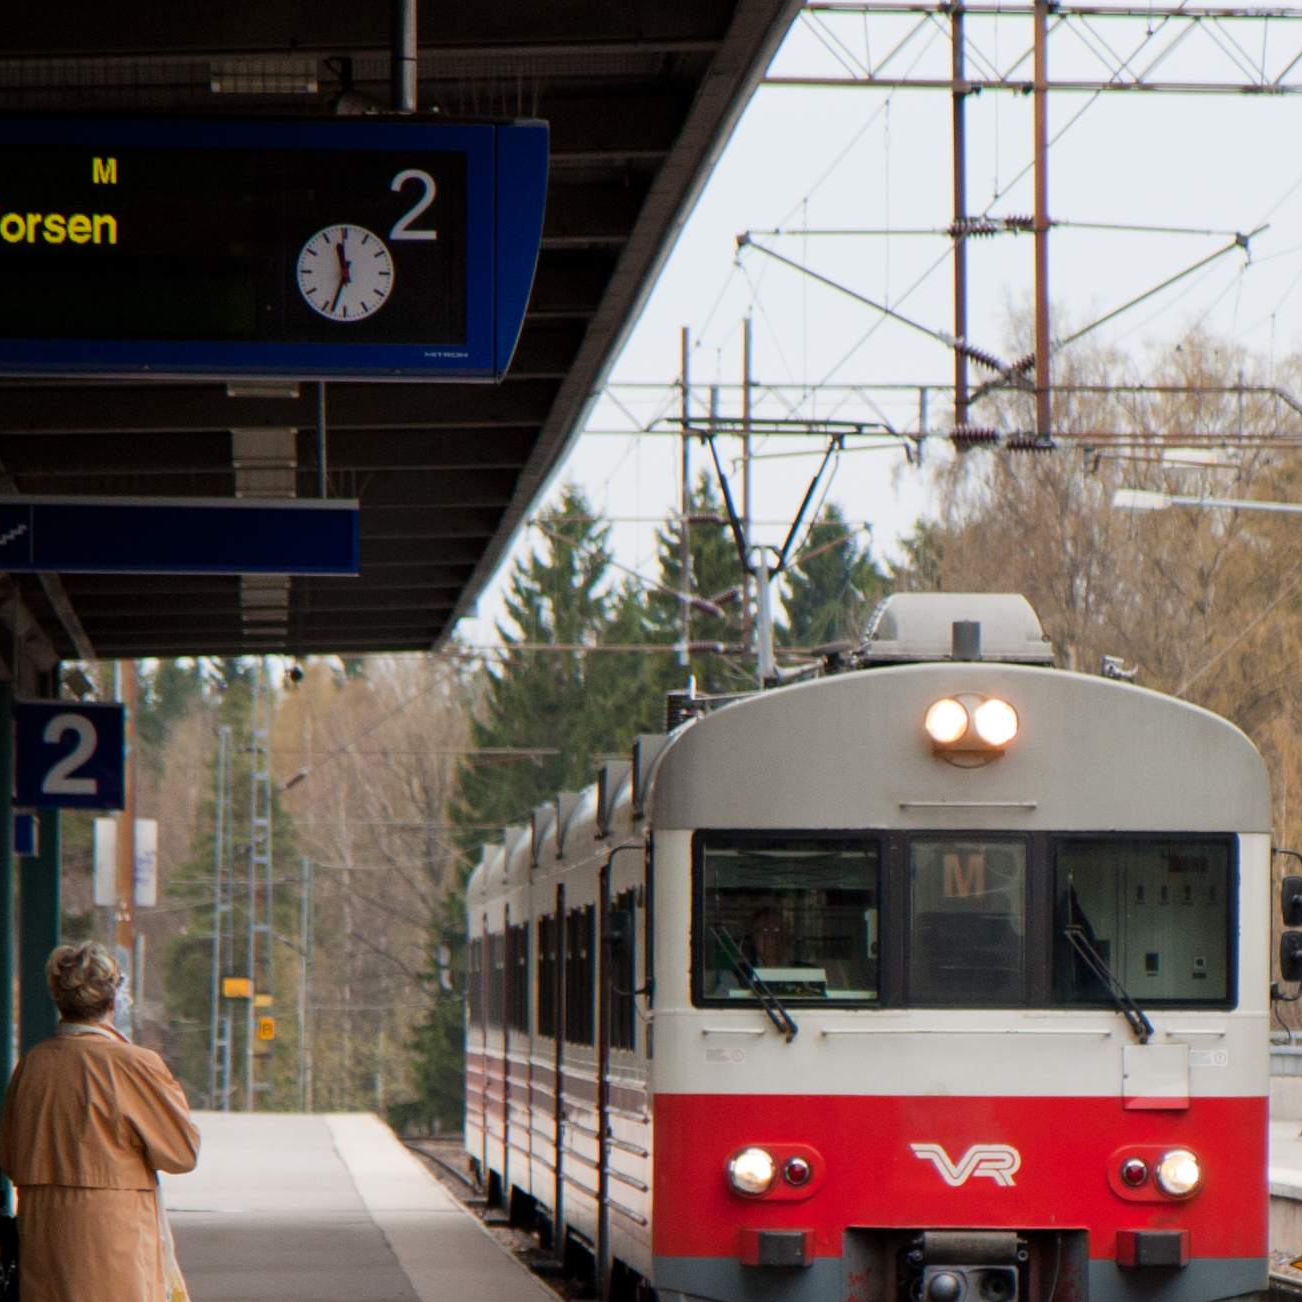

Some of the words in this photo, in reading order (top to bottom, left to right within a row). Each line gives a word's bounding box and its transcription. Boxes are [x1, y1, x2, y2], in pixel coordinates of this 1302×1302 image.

[92, 157, 117, 185] M
[390, 168, 438, 242] 2
[41, 713, 97, 795] 2
[942, 853, 986, 897] M
[907, 1140, 1022, 1187] VR
